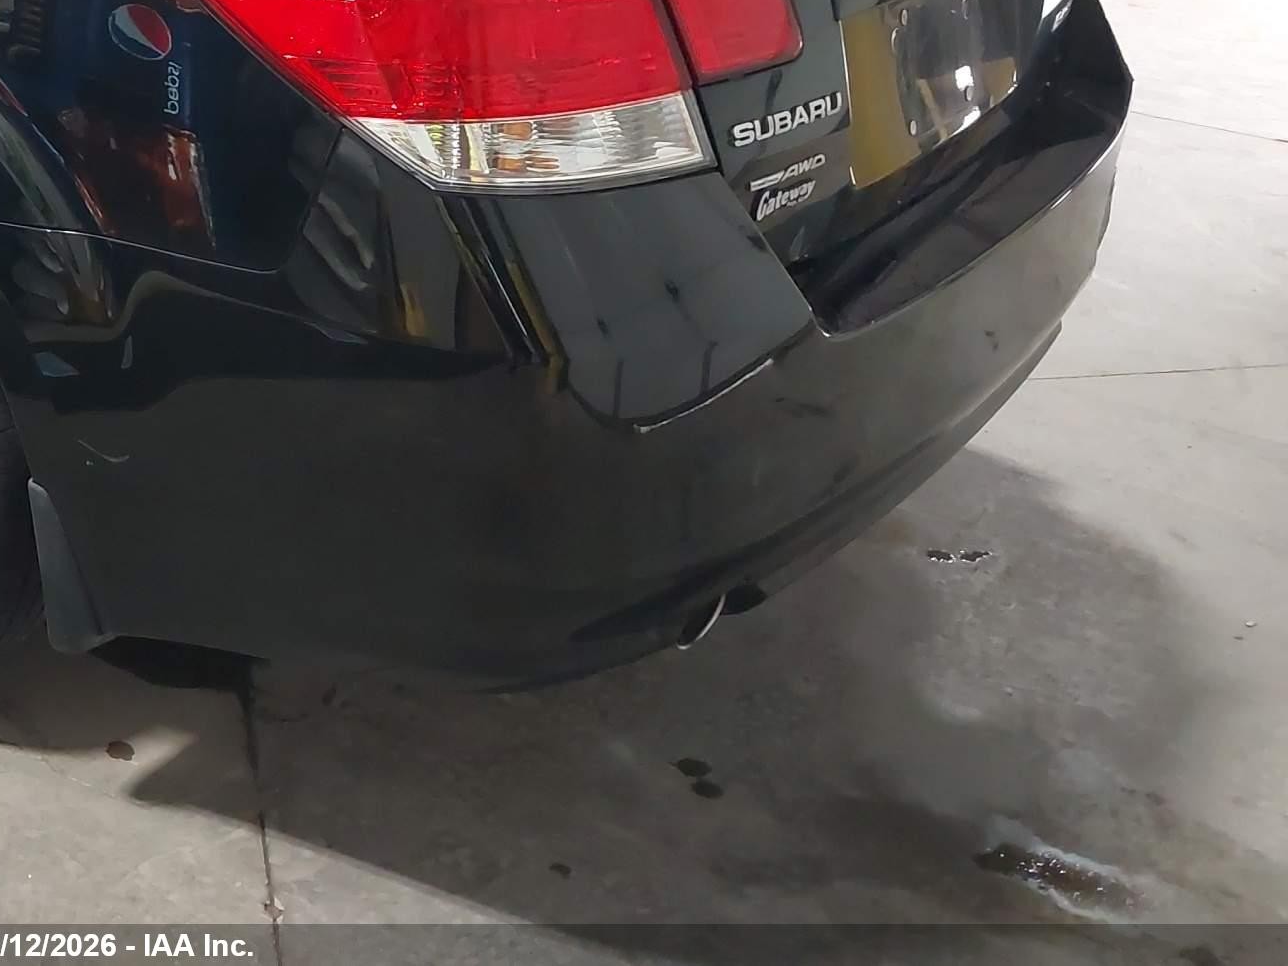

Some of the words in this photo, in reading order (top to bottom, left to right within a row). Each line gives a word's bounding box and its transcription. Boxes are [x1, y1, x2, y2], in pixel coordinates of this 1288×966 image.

[733, 92, 842, 147] SUBARU
[782, 154, 826, 182] AWD
[756, 180, 816, 221] Gateway
